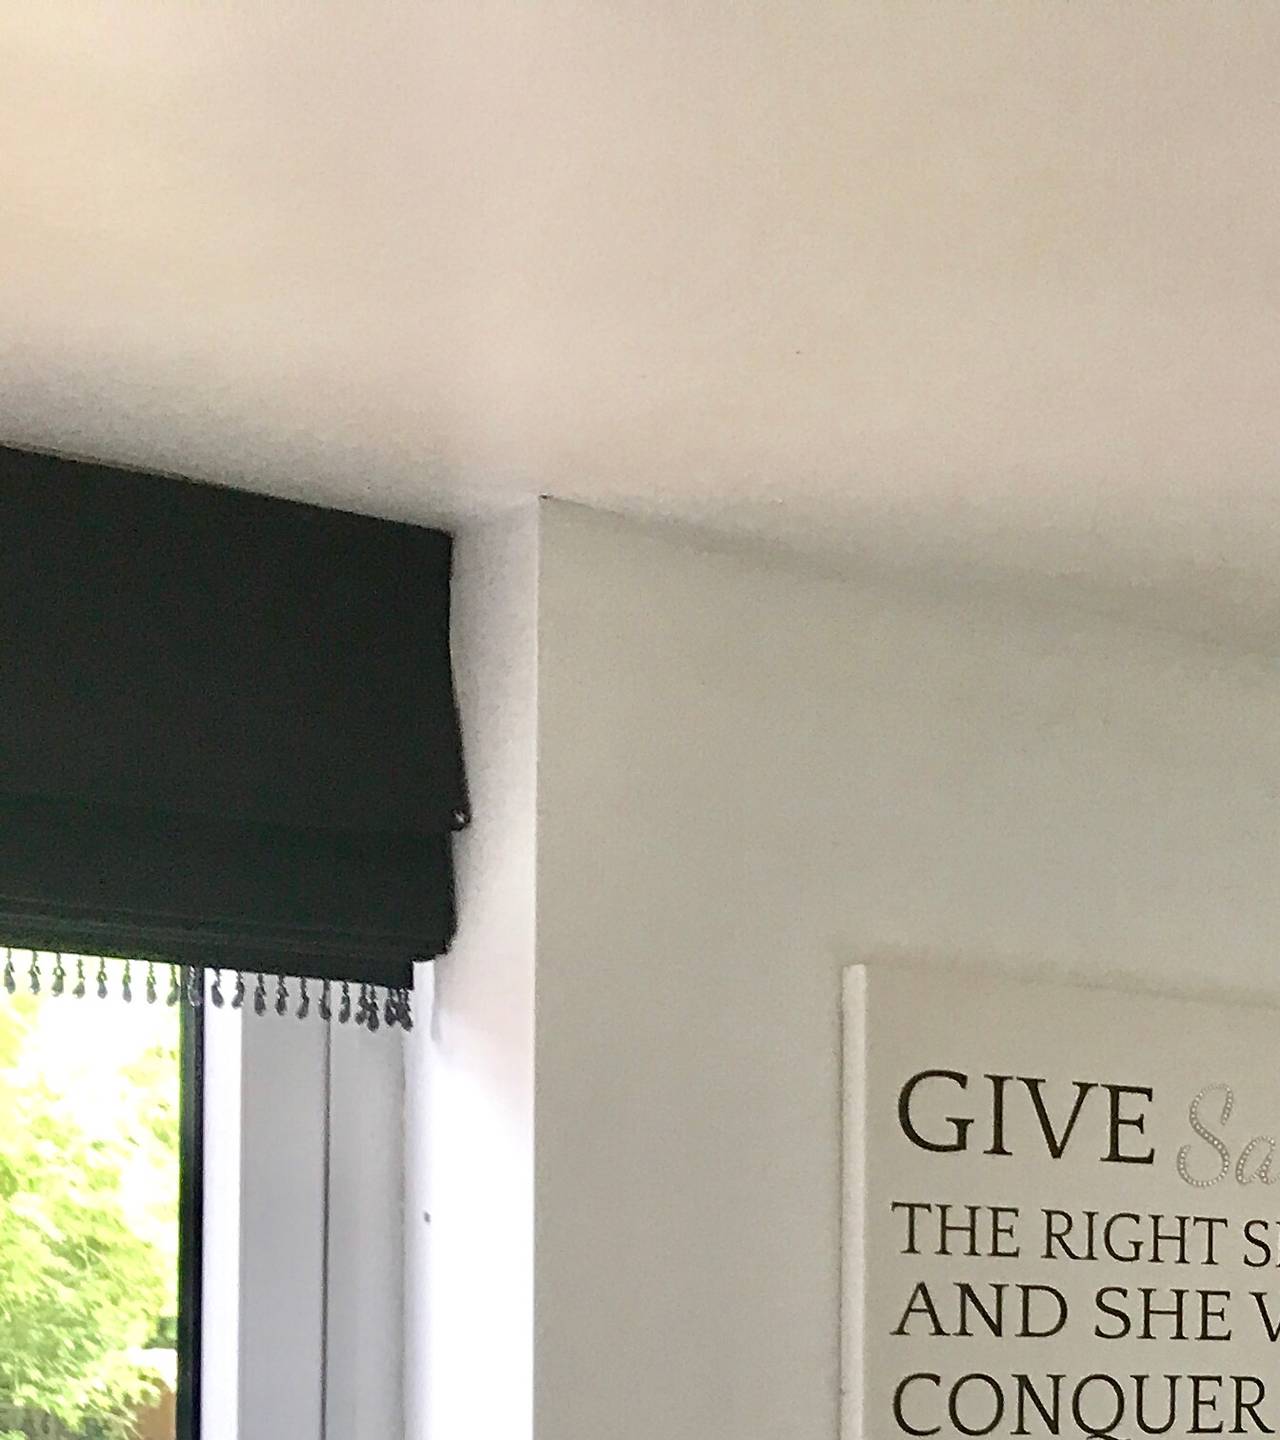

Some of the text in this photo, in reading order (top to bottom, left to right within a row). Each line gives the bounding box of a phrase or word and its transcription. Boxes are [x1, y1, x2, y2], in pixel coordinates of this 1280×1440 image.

[896, 1068, 1157, 1166] GIVE
[890, 1200, 1021, 1260] THE
[1040, 1207, 1229, 1267] RIGHT
[889, 1280, 1069, 1338] AND
[1093, 1285, 1233, 1342] SHE
